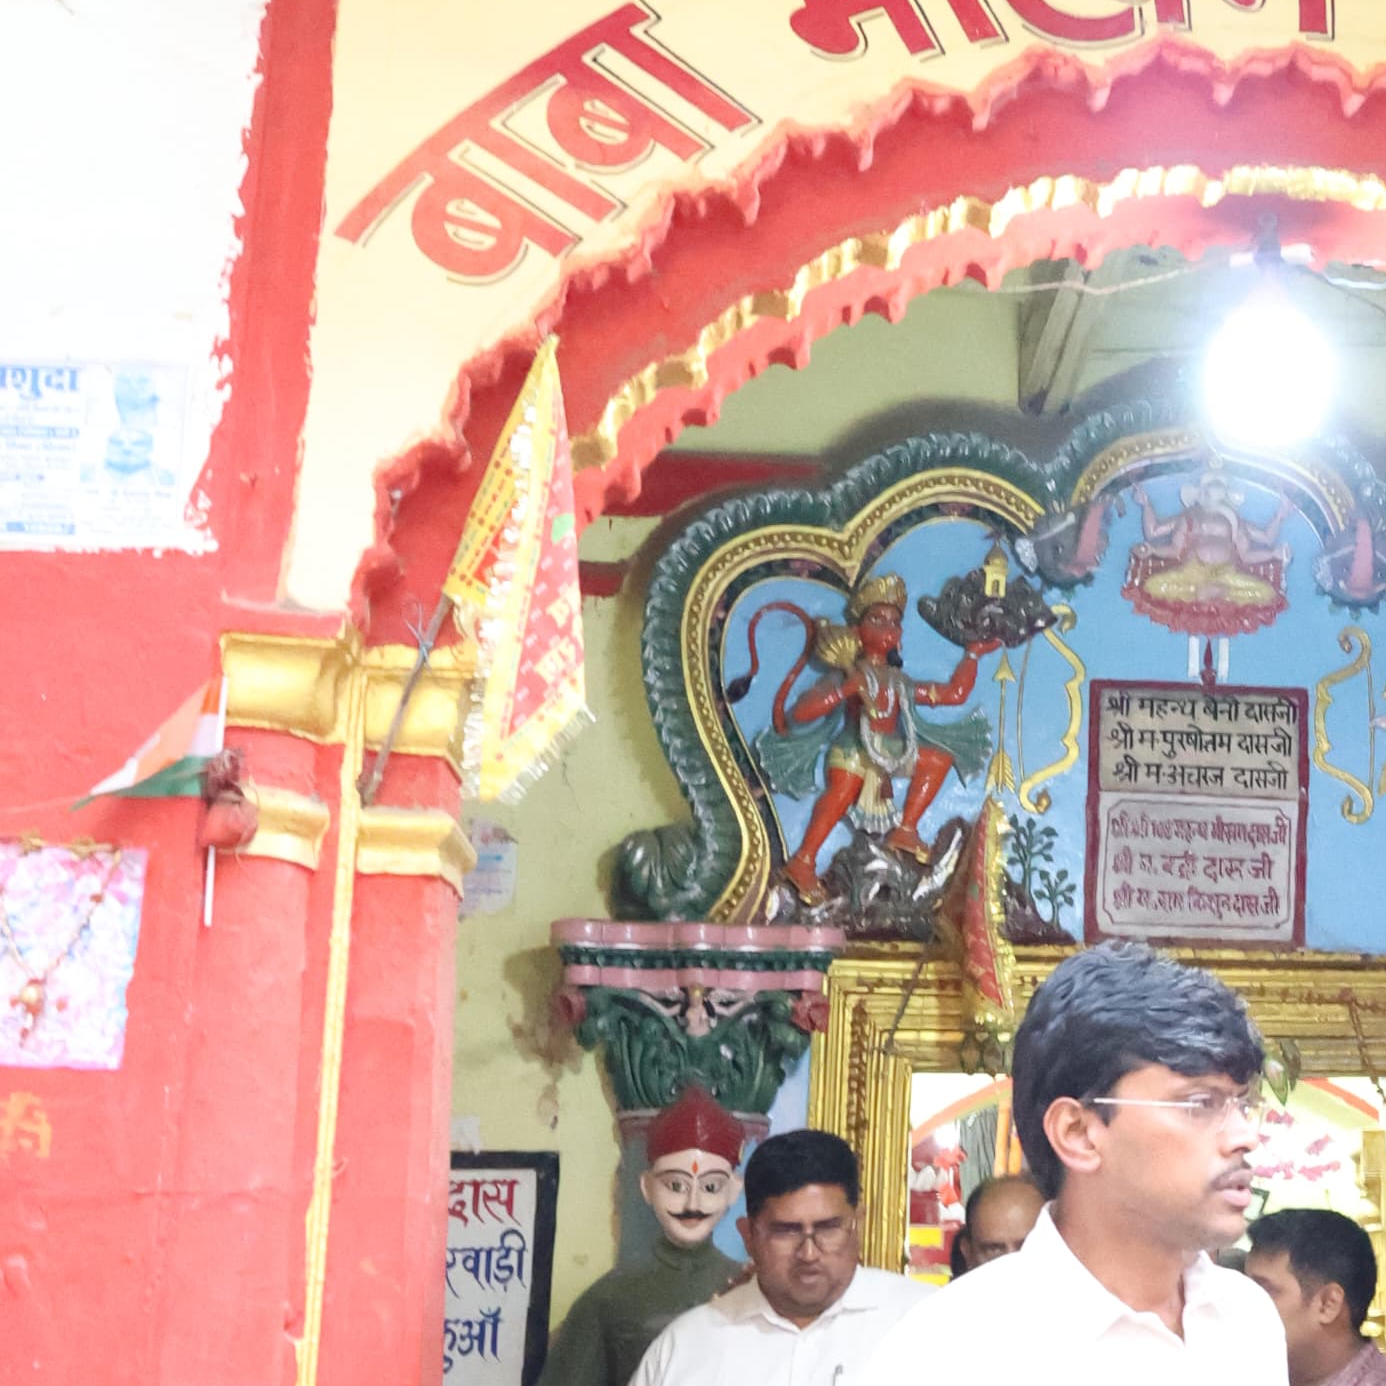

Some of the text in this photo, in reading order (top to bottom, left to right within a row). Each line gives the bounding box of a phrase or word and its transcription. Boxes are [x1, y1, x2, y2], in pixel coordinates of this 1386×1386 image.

[1107, 721, 1134, 750] श्री
[1112, 754, 1138, 783] श्री
[446, 1228, 528, 1299] रवाड़ी
